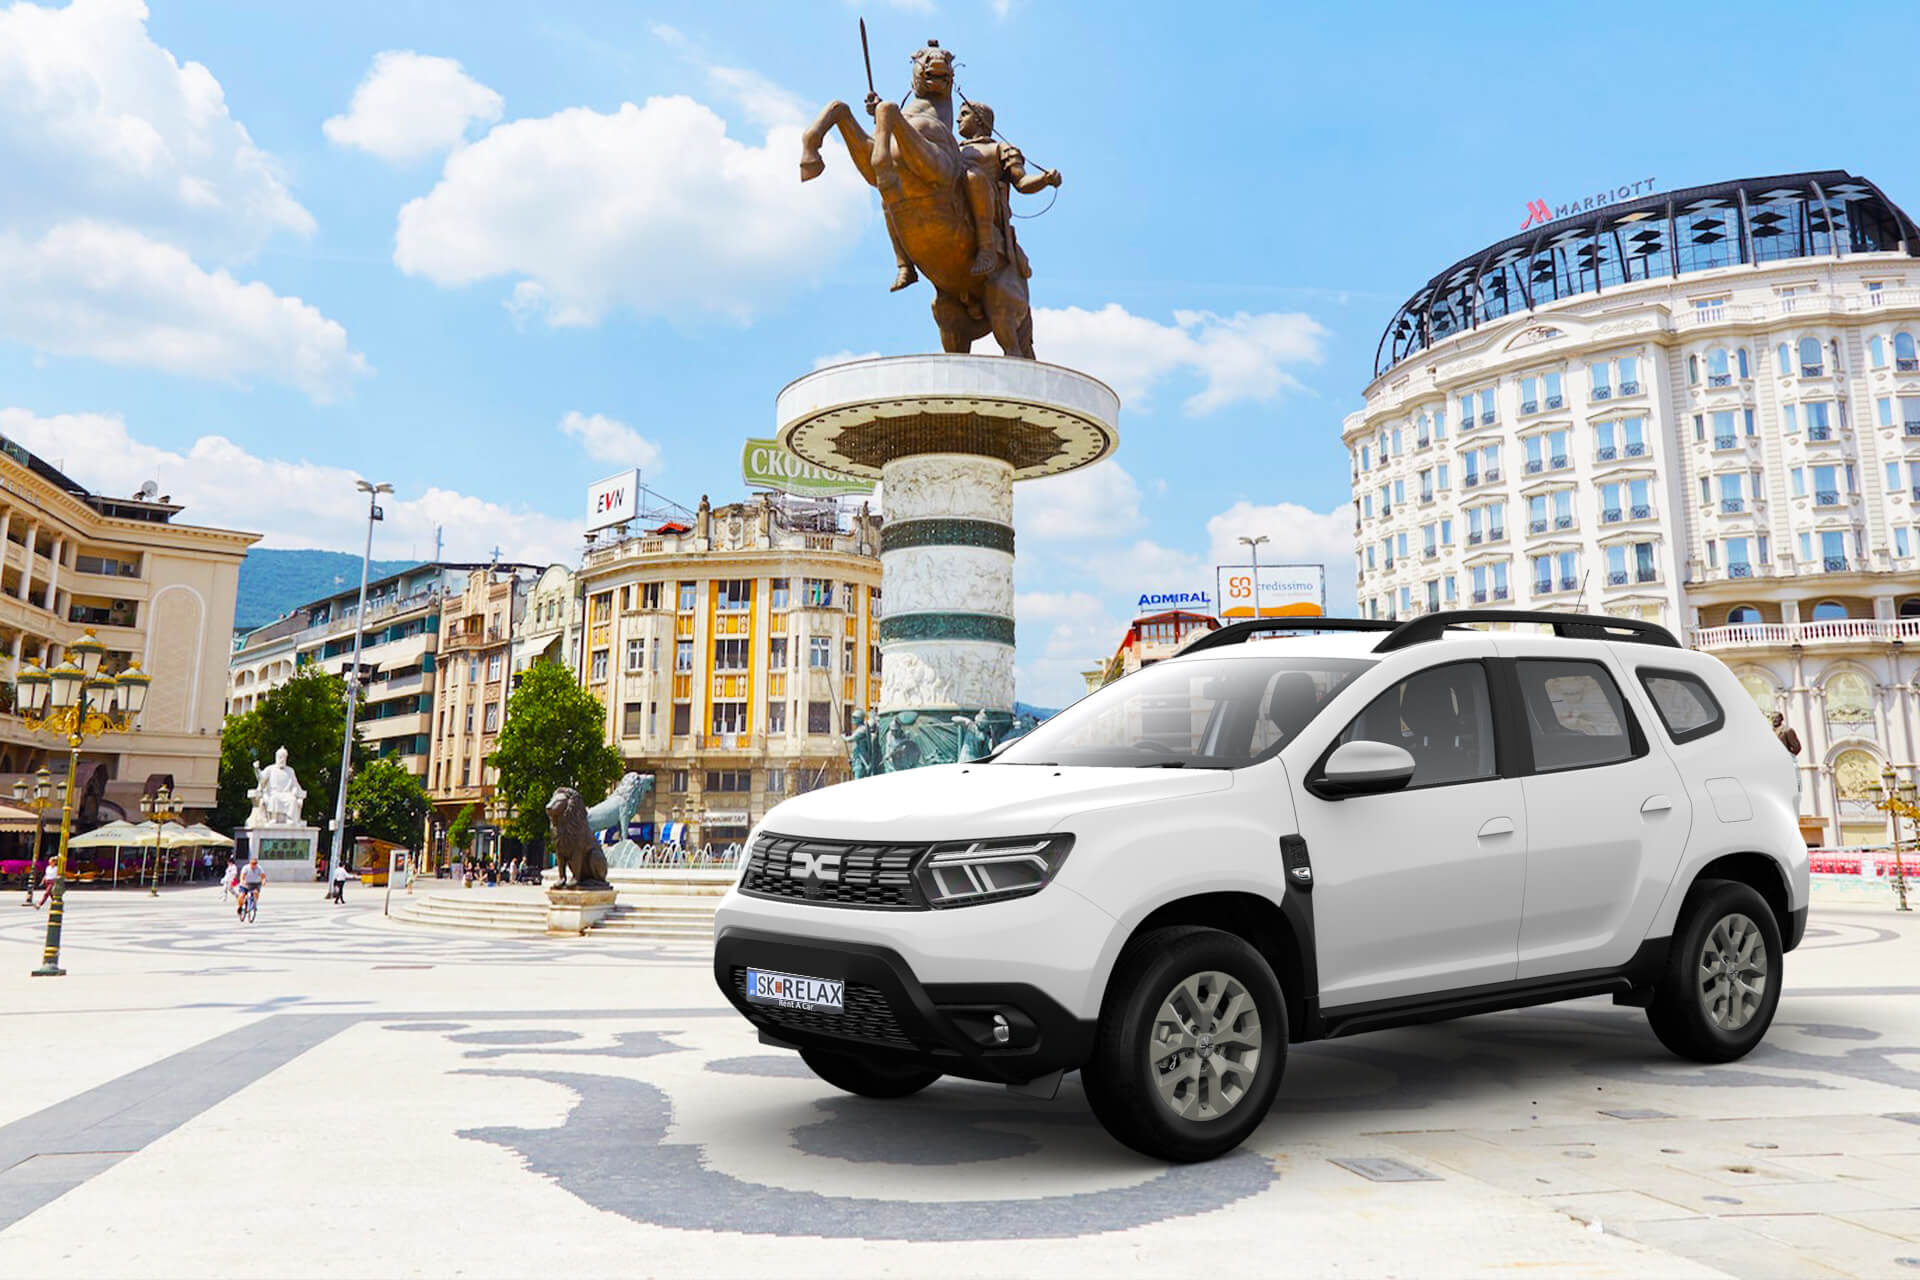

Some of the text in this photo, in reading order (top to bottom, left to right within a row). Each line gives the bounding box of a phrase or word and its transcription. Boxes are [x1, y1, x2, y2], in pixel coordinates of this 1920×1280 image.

[1555, 177, 1656, 218] MARRIOTT
[597, 487, 625, 514] EVN
[1138, 591, 1211, 606] ADMIRAL
[758, 975, 841, 1005] SK RELAX
